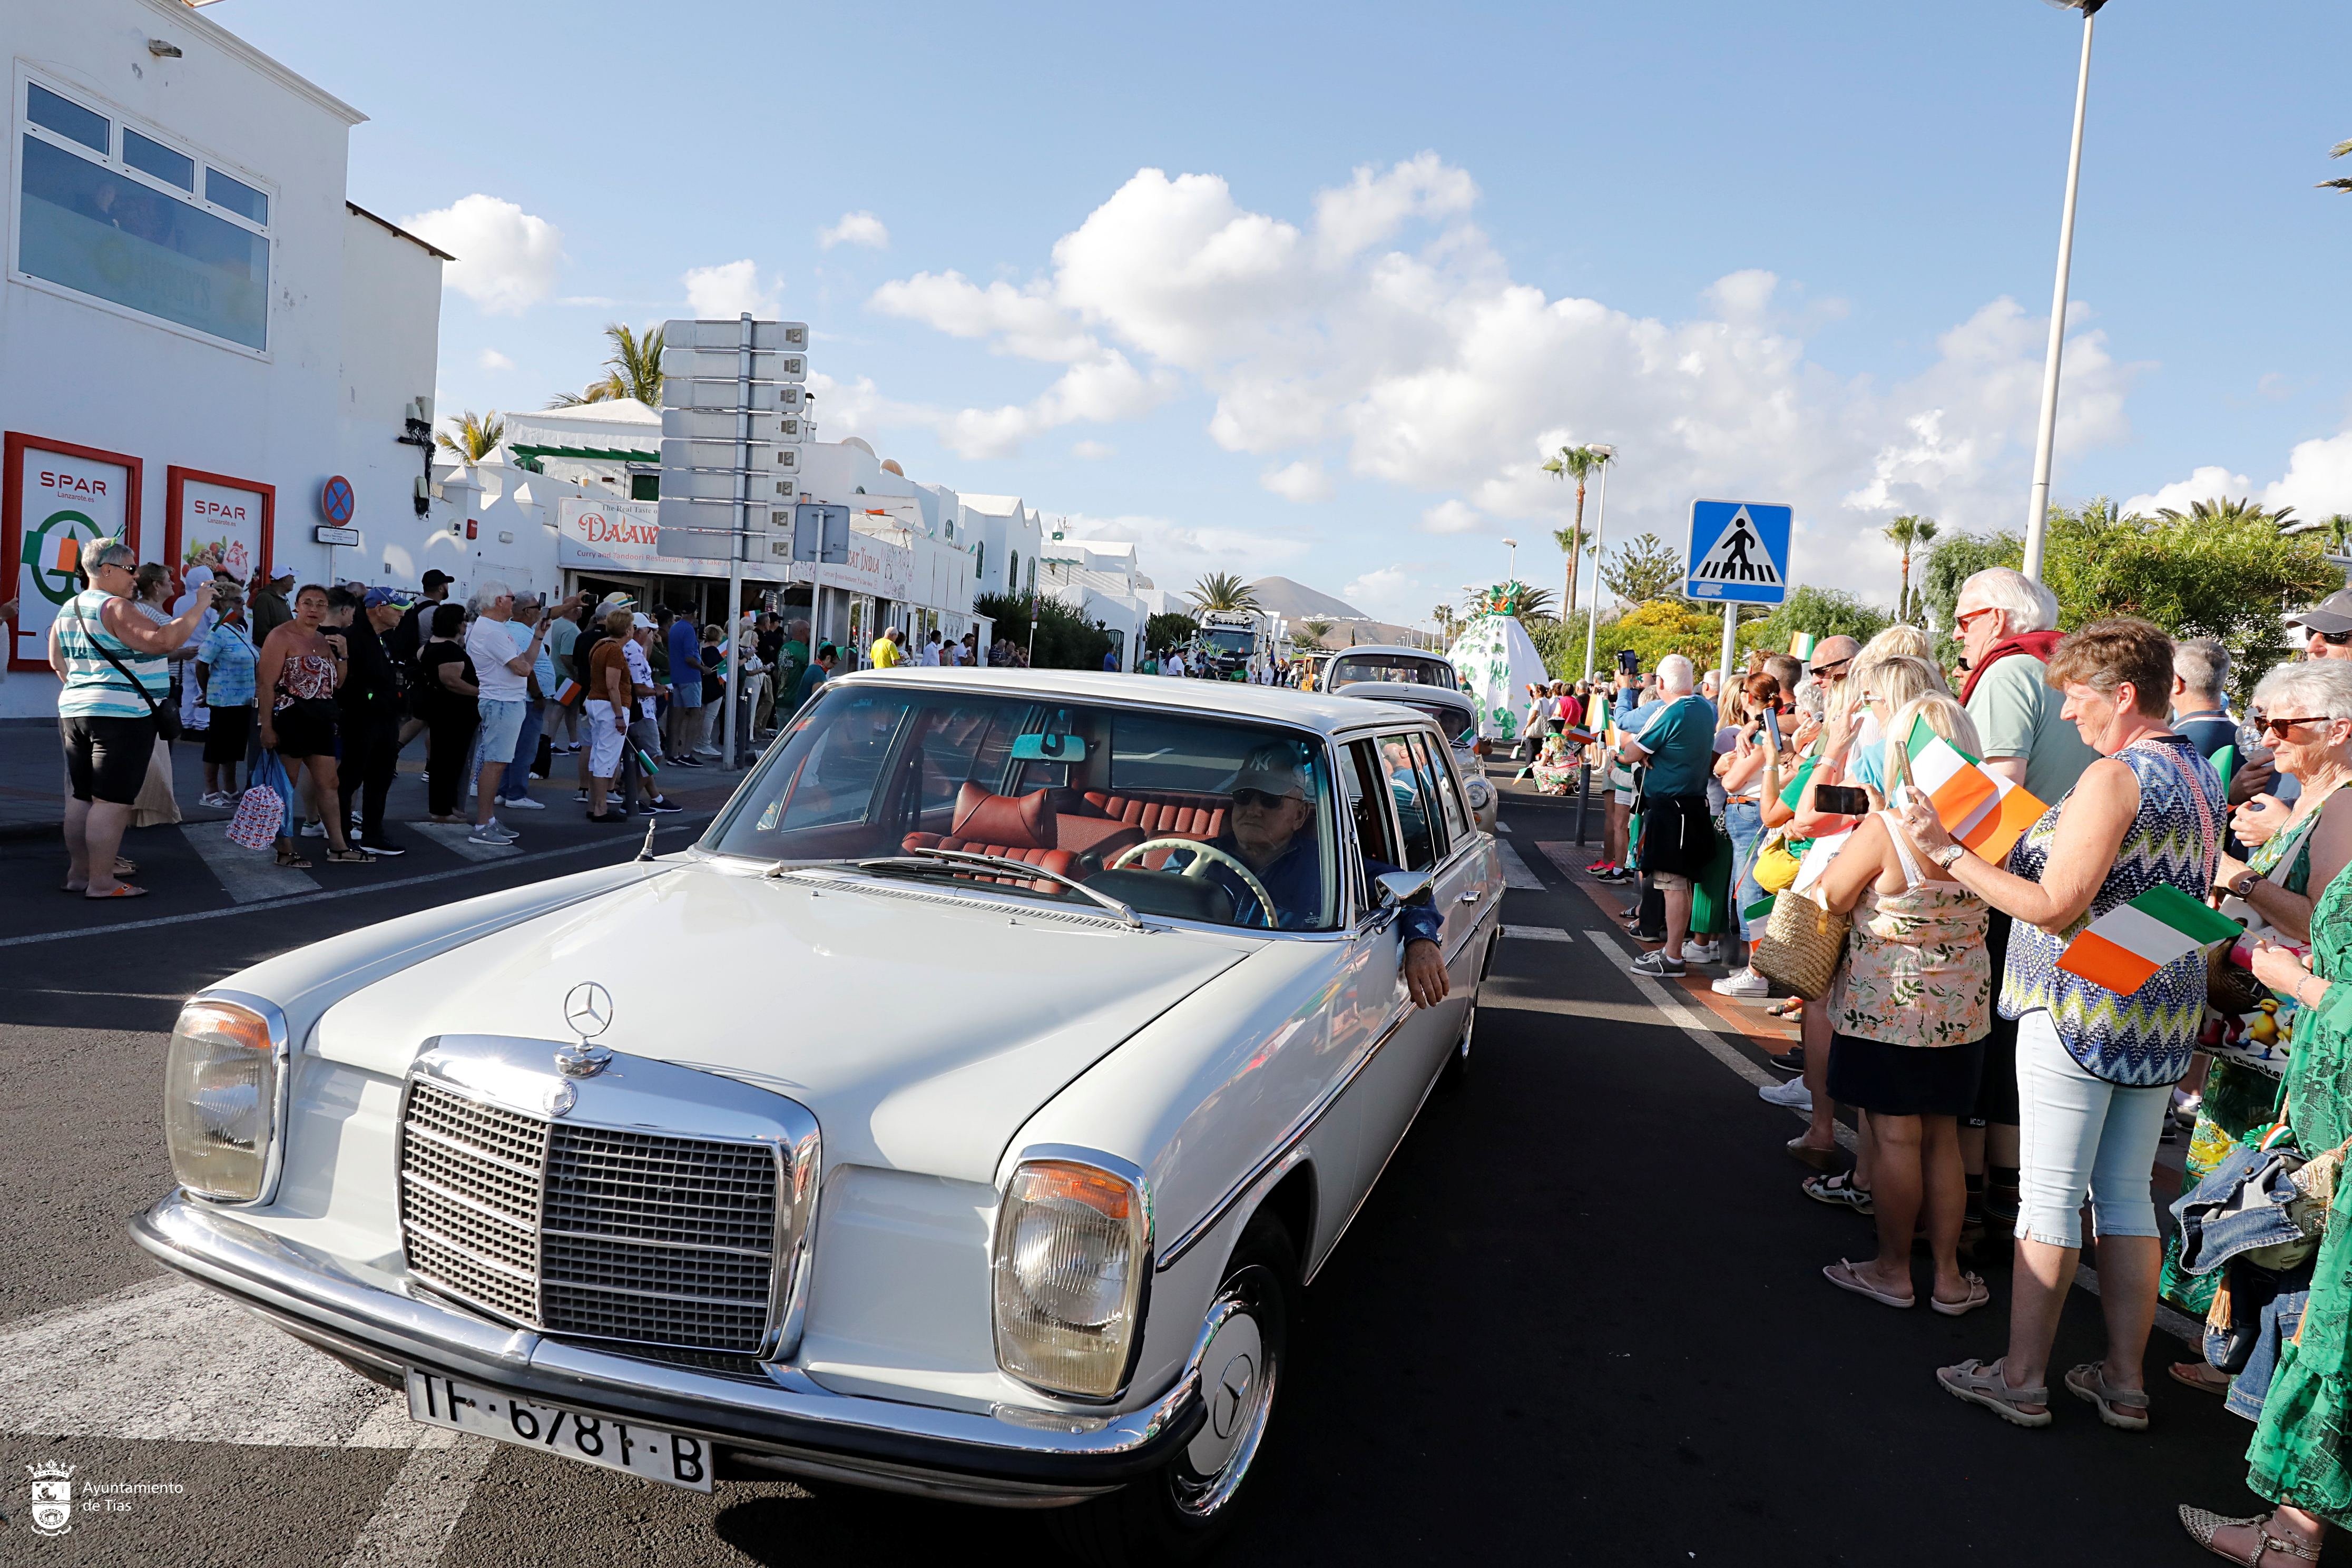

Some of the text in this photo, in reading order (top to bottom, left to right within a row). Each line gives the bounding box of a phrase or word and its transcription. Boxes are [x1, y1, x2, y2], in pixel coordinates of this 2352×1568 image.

[41, 471, 106, 496] SPAR
[57, 491, 94, 503] Lanzarote.es
[194, 500, 245, 521] SPAR
[208, 517, 236, 527] Lanzarote.es
[577, 550, 596, 558] Curry
[613, 552, 644, 561] Tandoori
[646, 555, 684, 564] Restaurant
